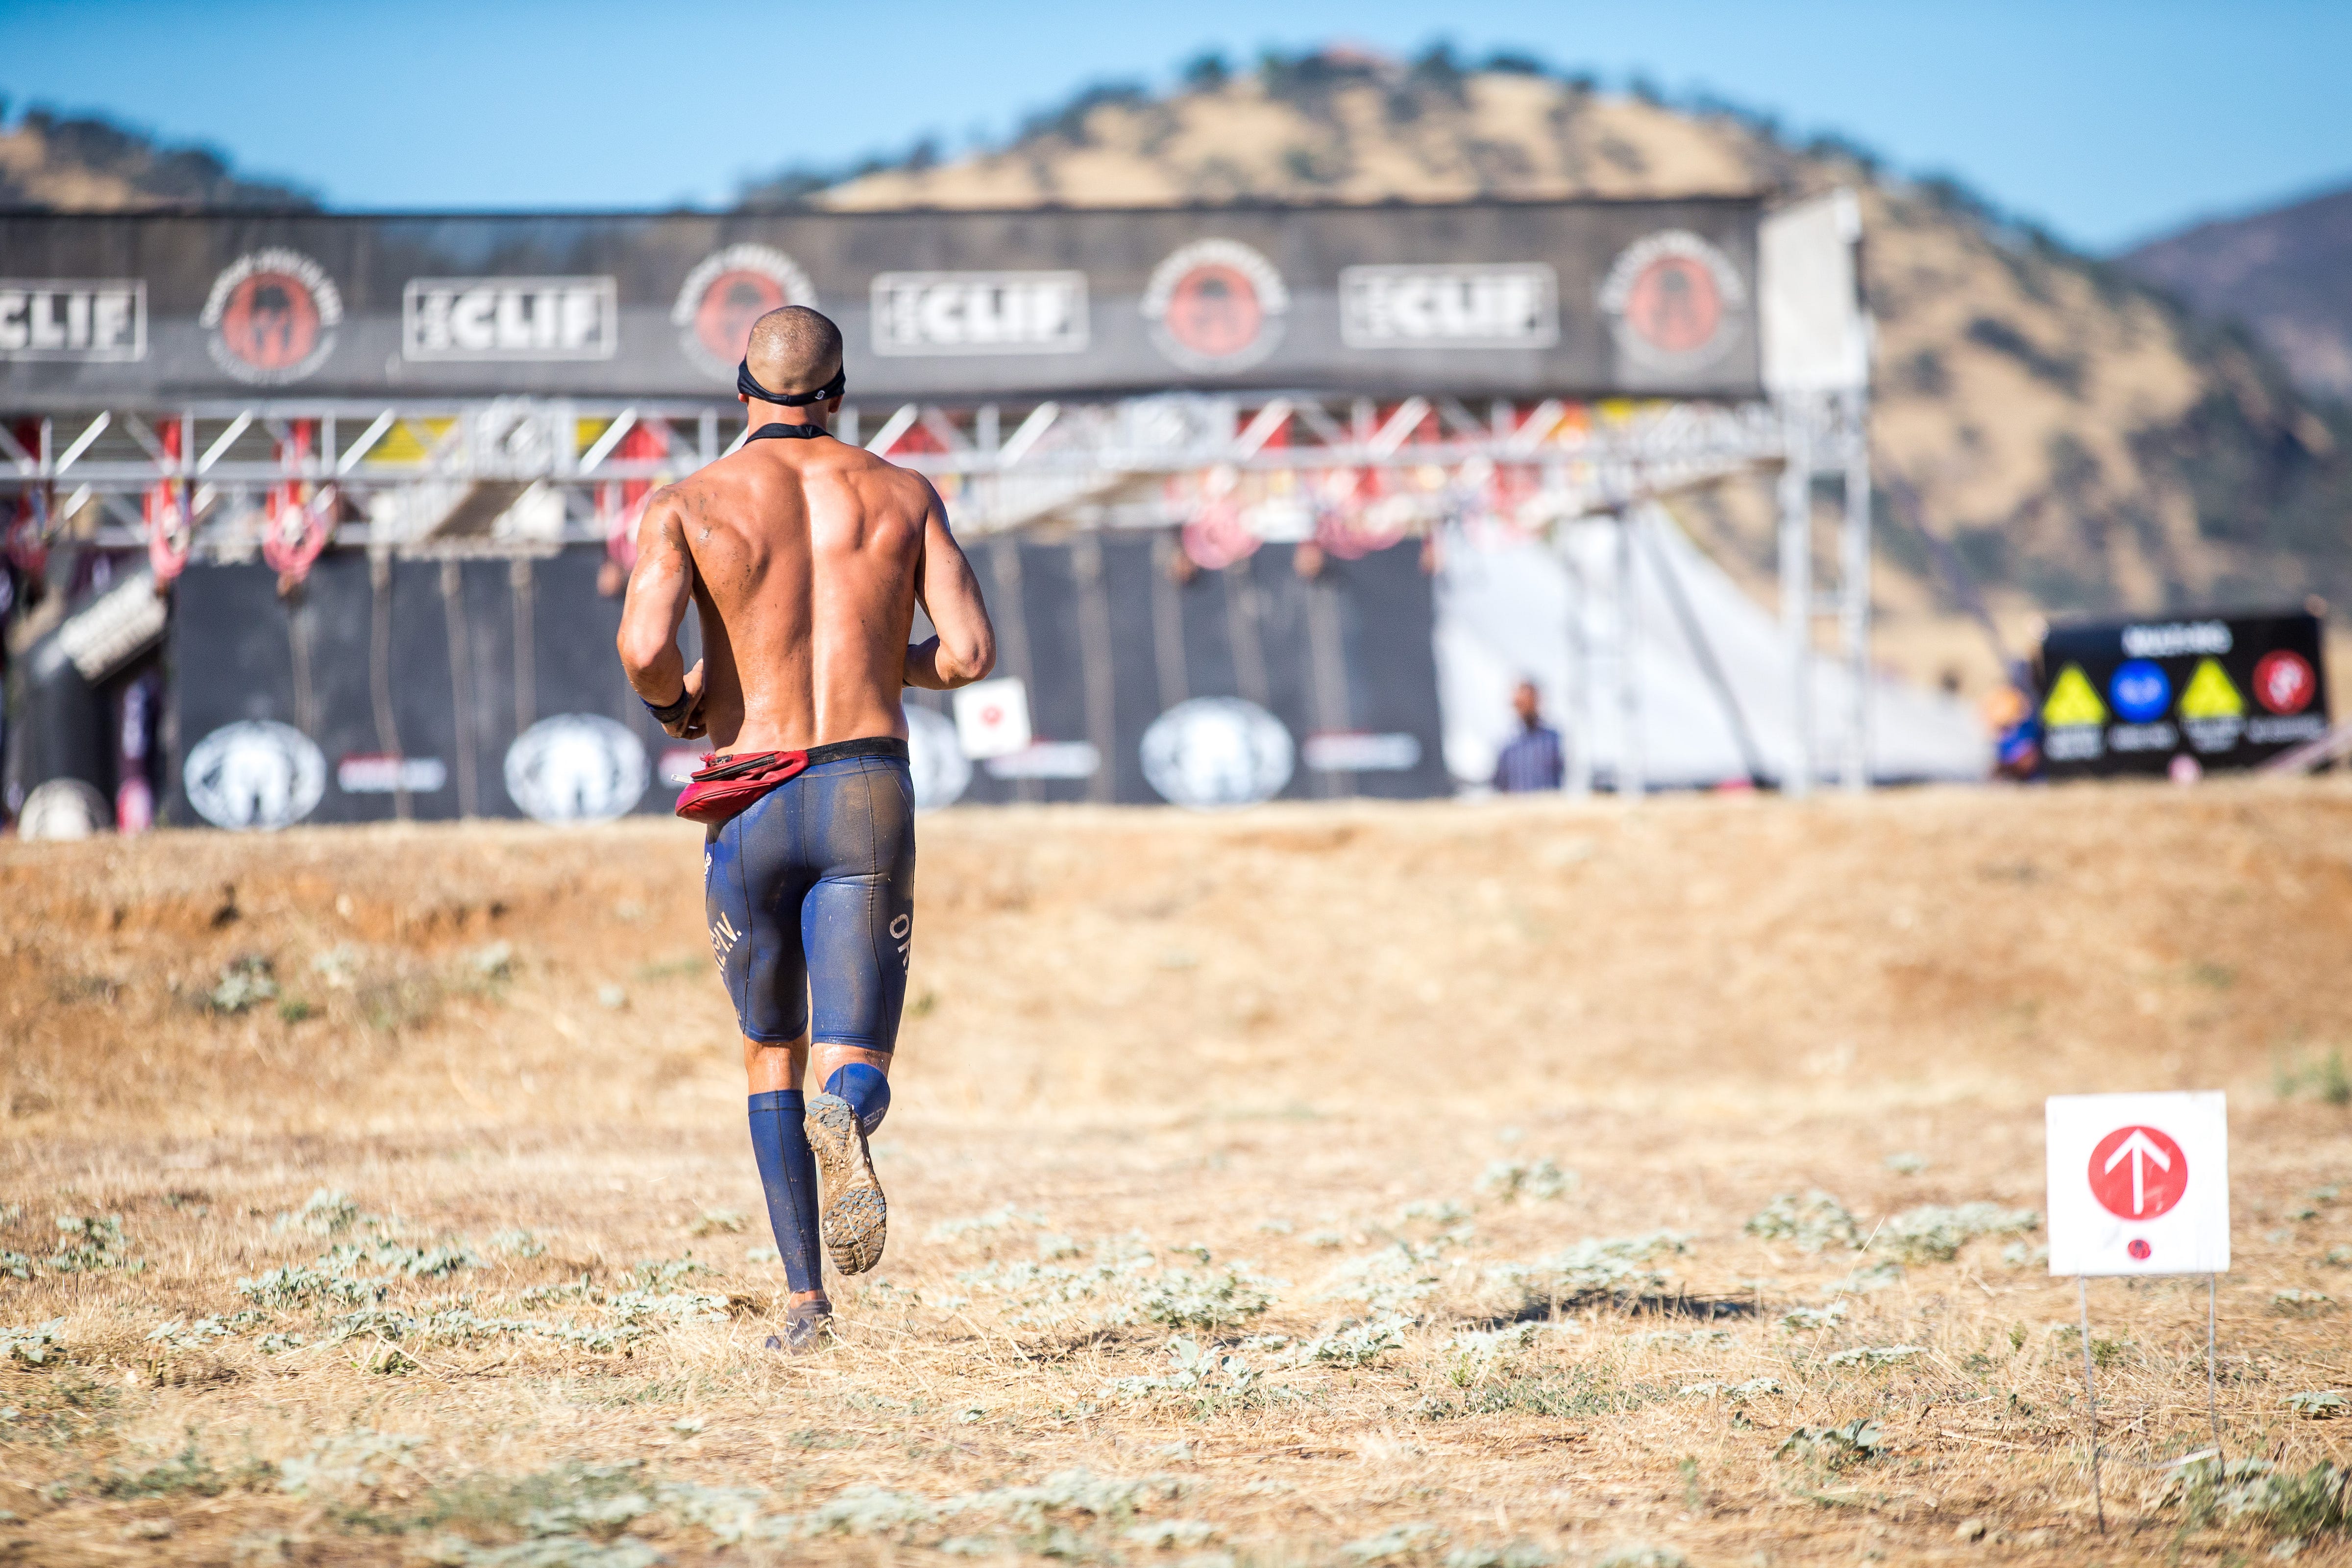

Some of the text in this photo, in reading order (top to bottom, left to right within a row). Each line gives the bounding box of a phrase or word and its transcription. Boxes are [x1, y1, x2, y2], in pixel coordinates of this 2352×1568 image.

[0, 291, 127, 349] CLIF
[450, 288, 598, 349] CLIF
[921, 283, 1070, 344] CLIF
[1393, 275, 1544, 338] CLIF
